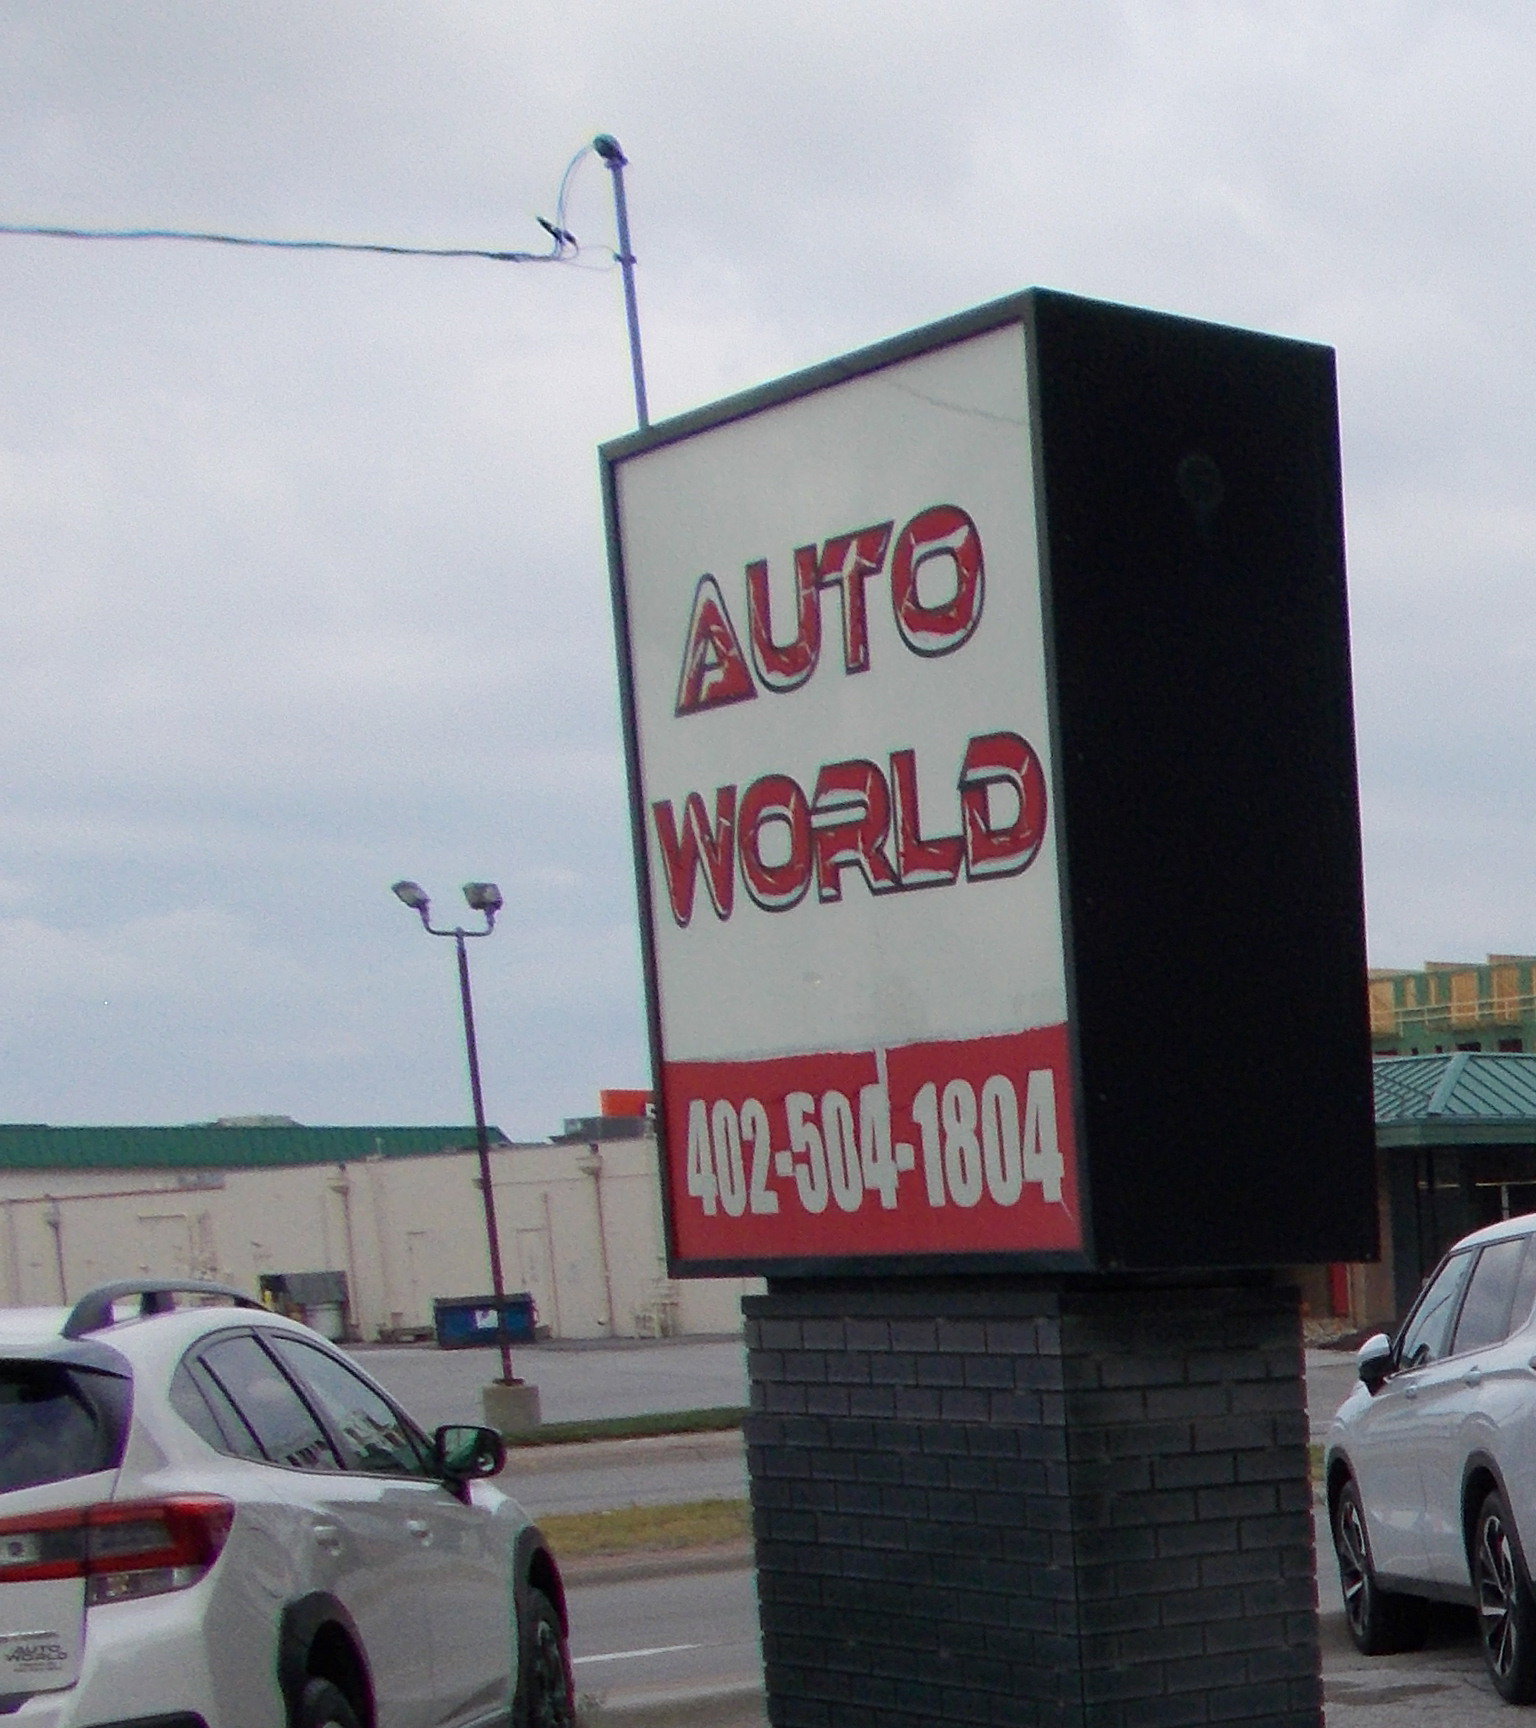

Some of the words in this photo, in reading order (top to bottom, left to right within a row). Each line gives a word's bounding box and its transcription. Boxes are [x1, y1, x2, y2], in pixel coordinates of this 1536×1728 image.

[674, 503, 986, 718] AUTO
[651, 731, 1048, 927] WORLD
[686, 1067, 1065, 1217] 402-504-1804
